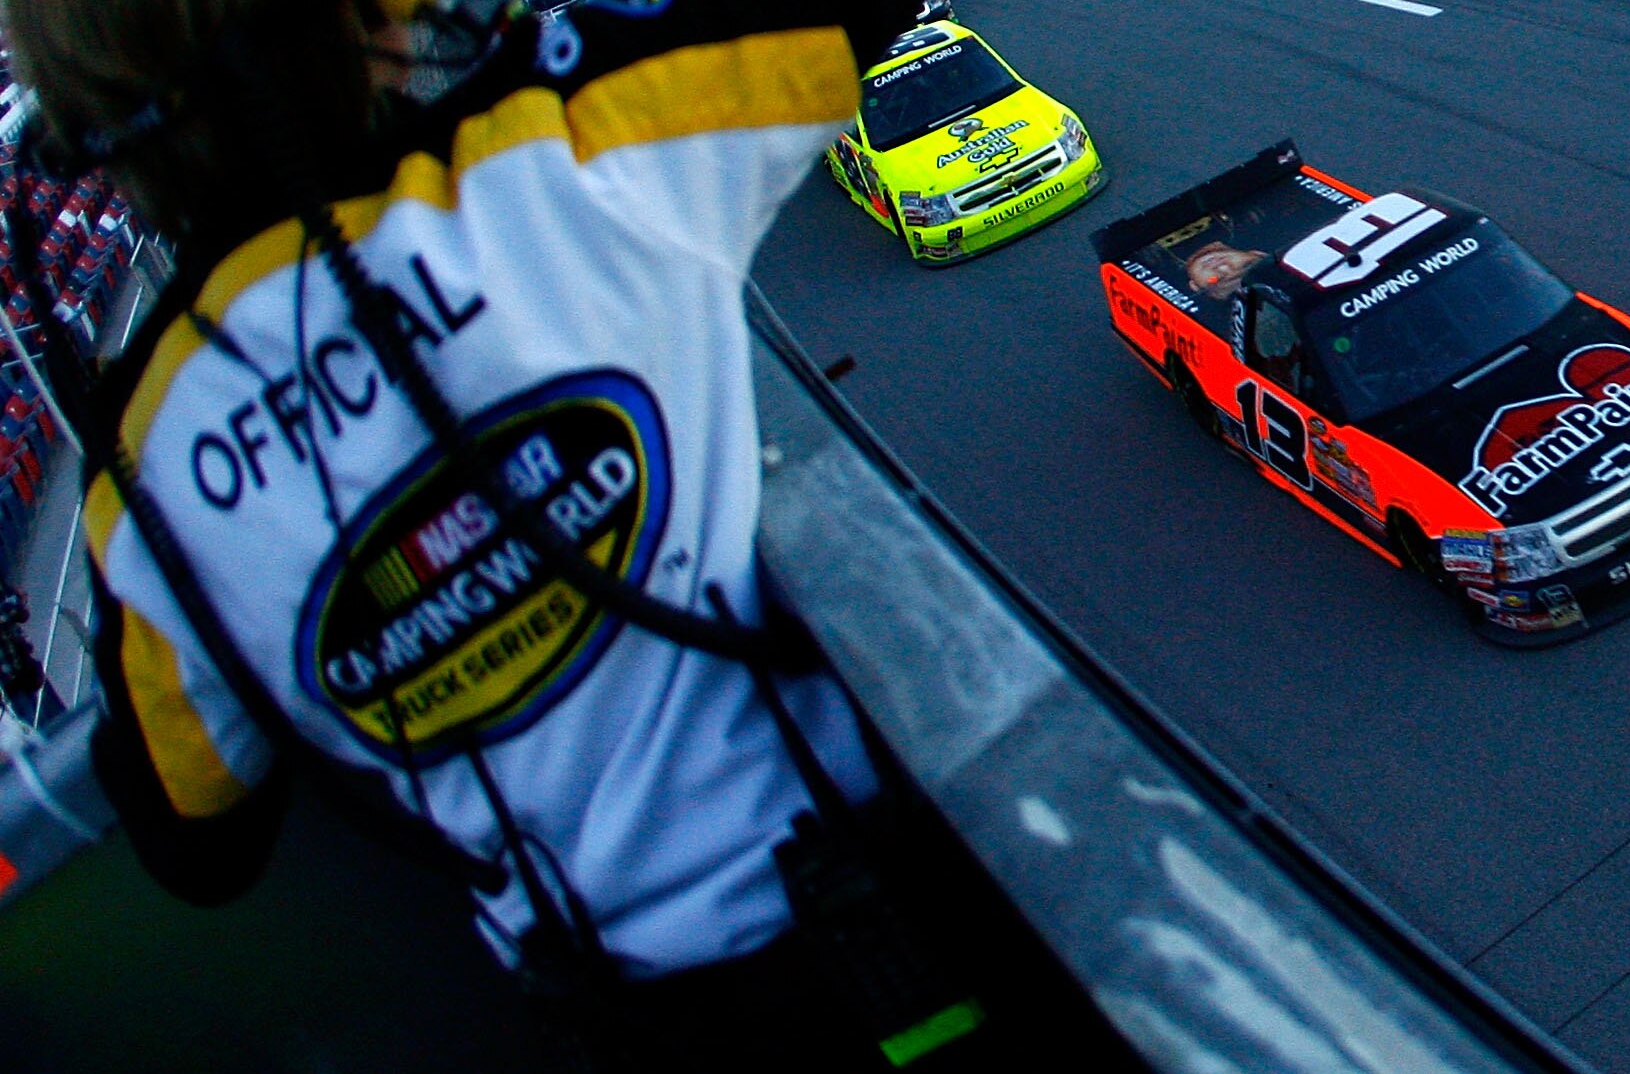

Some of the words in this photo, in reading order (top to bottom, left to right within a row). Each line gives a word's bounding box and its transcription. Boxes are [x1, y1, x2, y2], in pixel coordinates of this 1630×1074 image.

[874, 61, 922, 88] CAMPING
[923, 44, 962, 65] WORLD
[937, 119, 1030, 168] Australian
[967, 138, 1016, 163] Gold
[983, 182, 1065, 227] SILVERADO
[1143, 276, 1195, 310] AMERICA
[1340, 269, 1420, 318] CAMPING
[1418, 237, 1480, 274] WORLD
[191, 255, 486, 512] OFFICAL
[1235, 378, 1314, 492] 13
[416, 433, 564, 573] NASAR
[475, 446, 637, 594] WRLD
[373, 669, 465, 733] TUCK
[462, 588, 576, 681] SERIES
